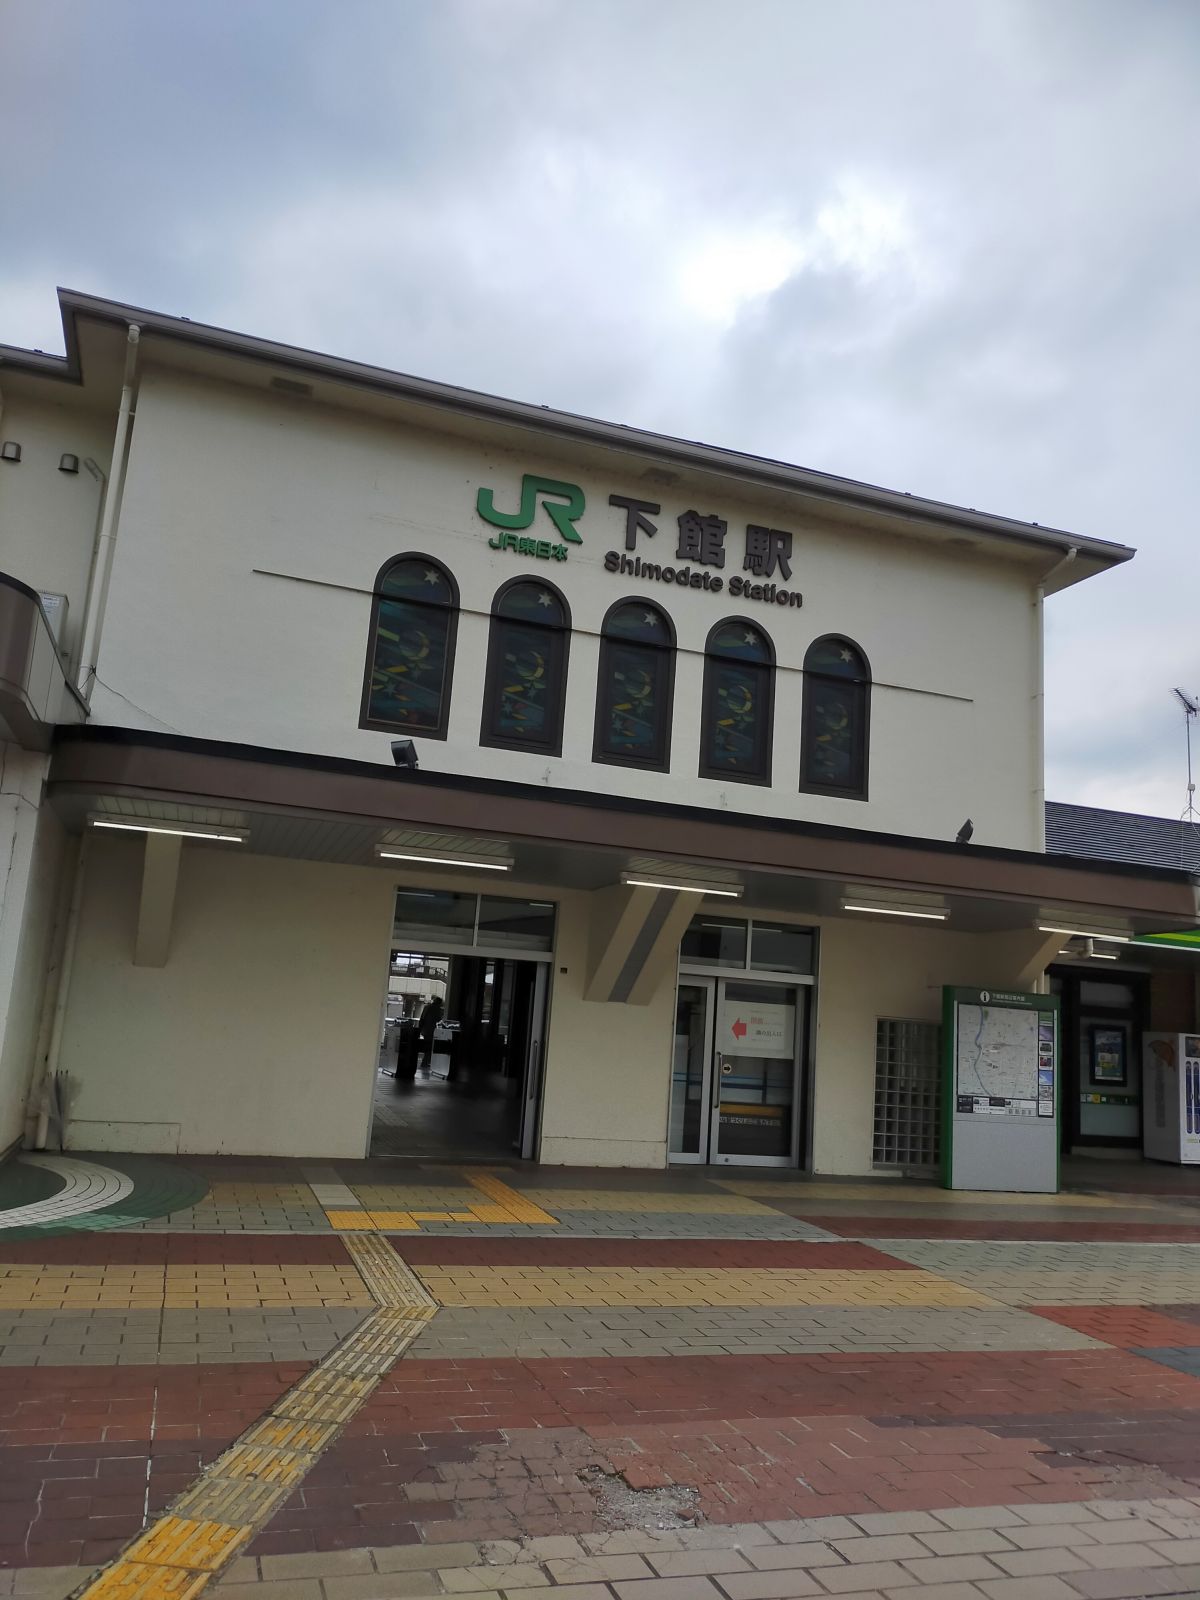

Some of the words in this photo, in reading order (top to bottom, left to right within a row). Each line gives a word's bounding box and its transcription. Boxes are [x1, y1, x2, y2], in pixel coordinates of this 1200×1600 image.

[477, 473, 586, 545] JR
[608, 494, 793, 581] 下館駅
[488, 532, 568, 562] JR東日本
[604, 550, 724, 592] Shimodate
[728, 575, 803, 608] Station
